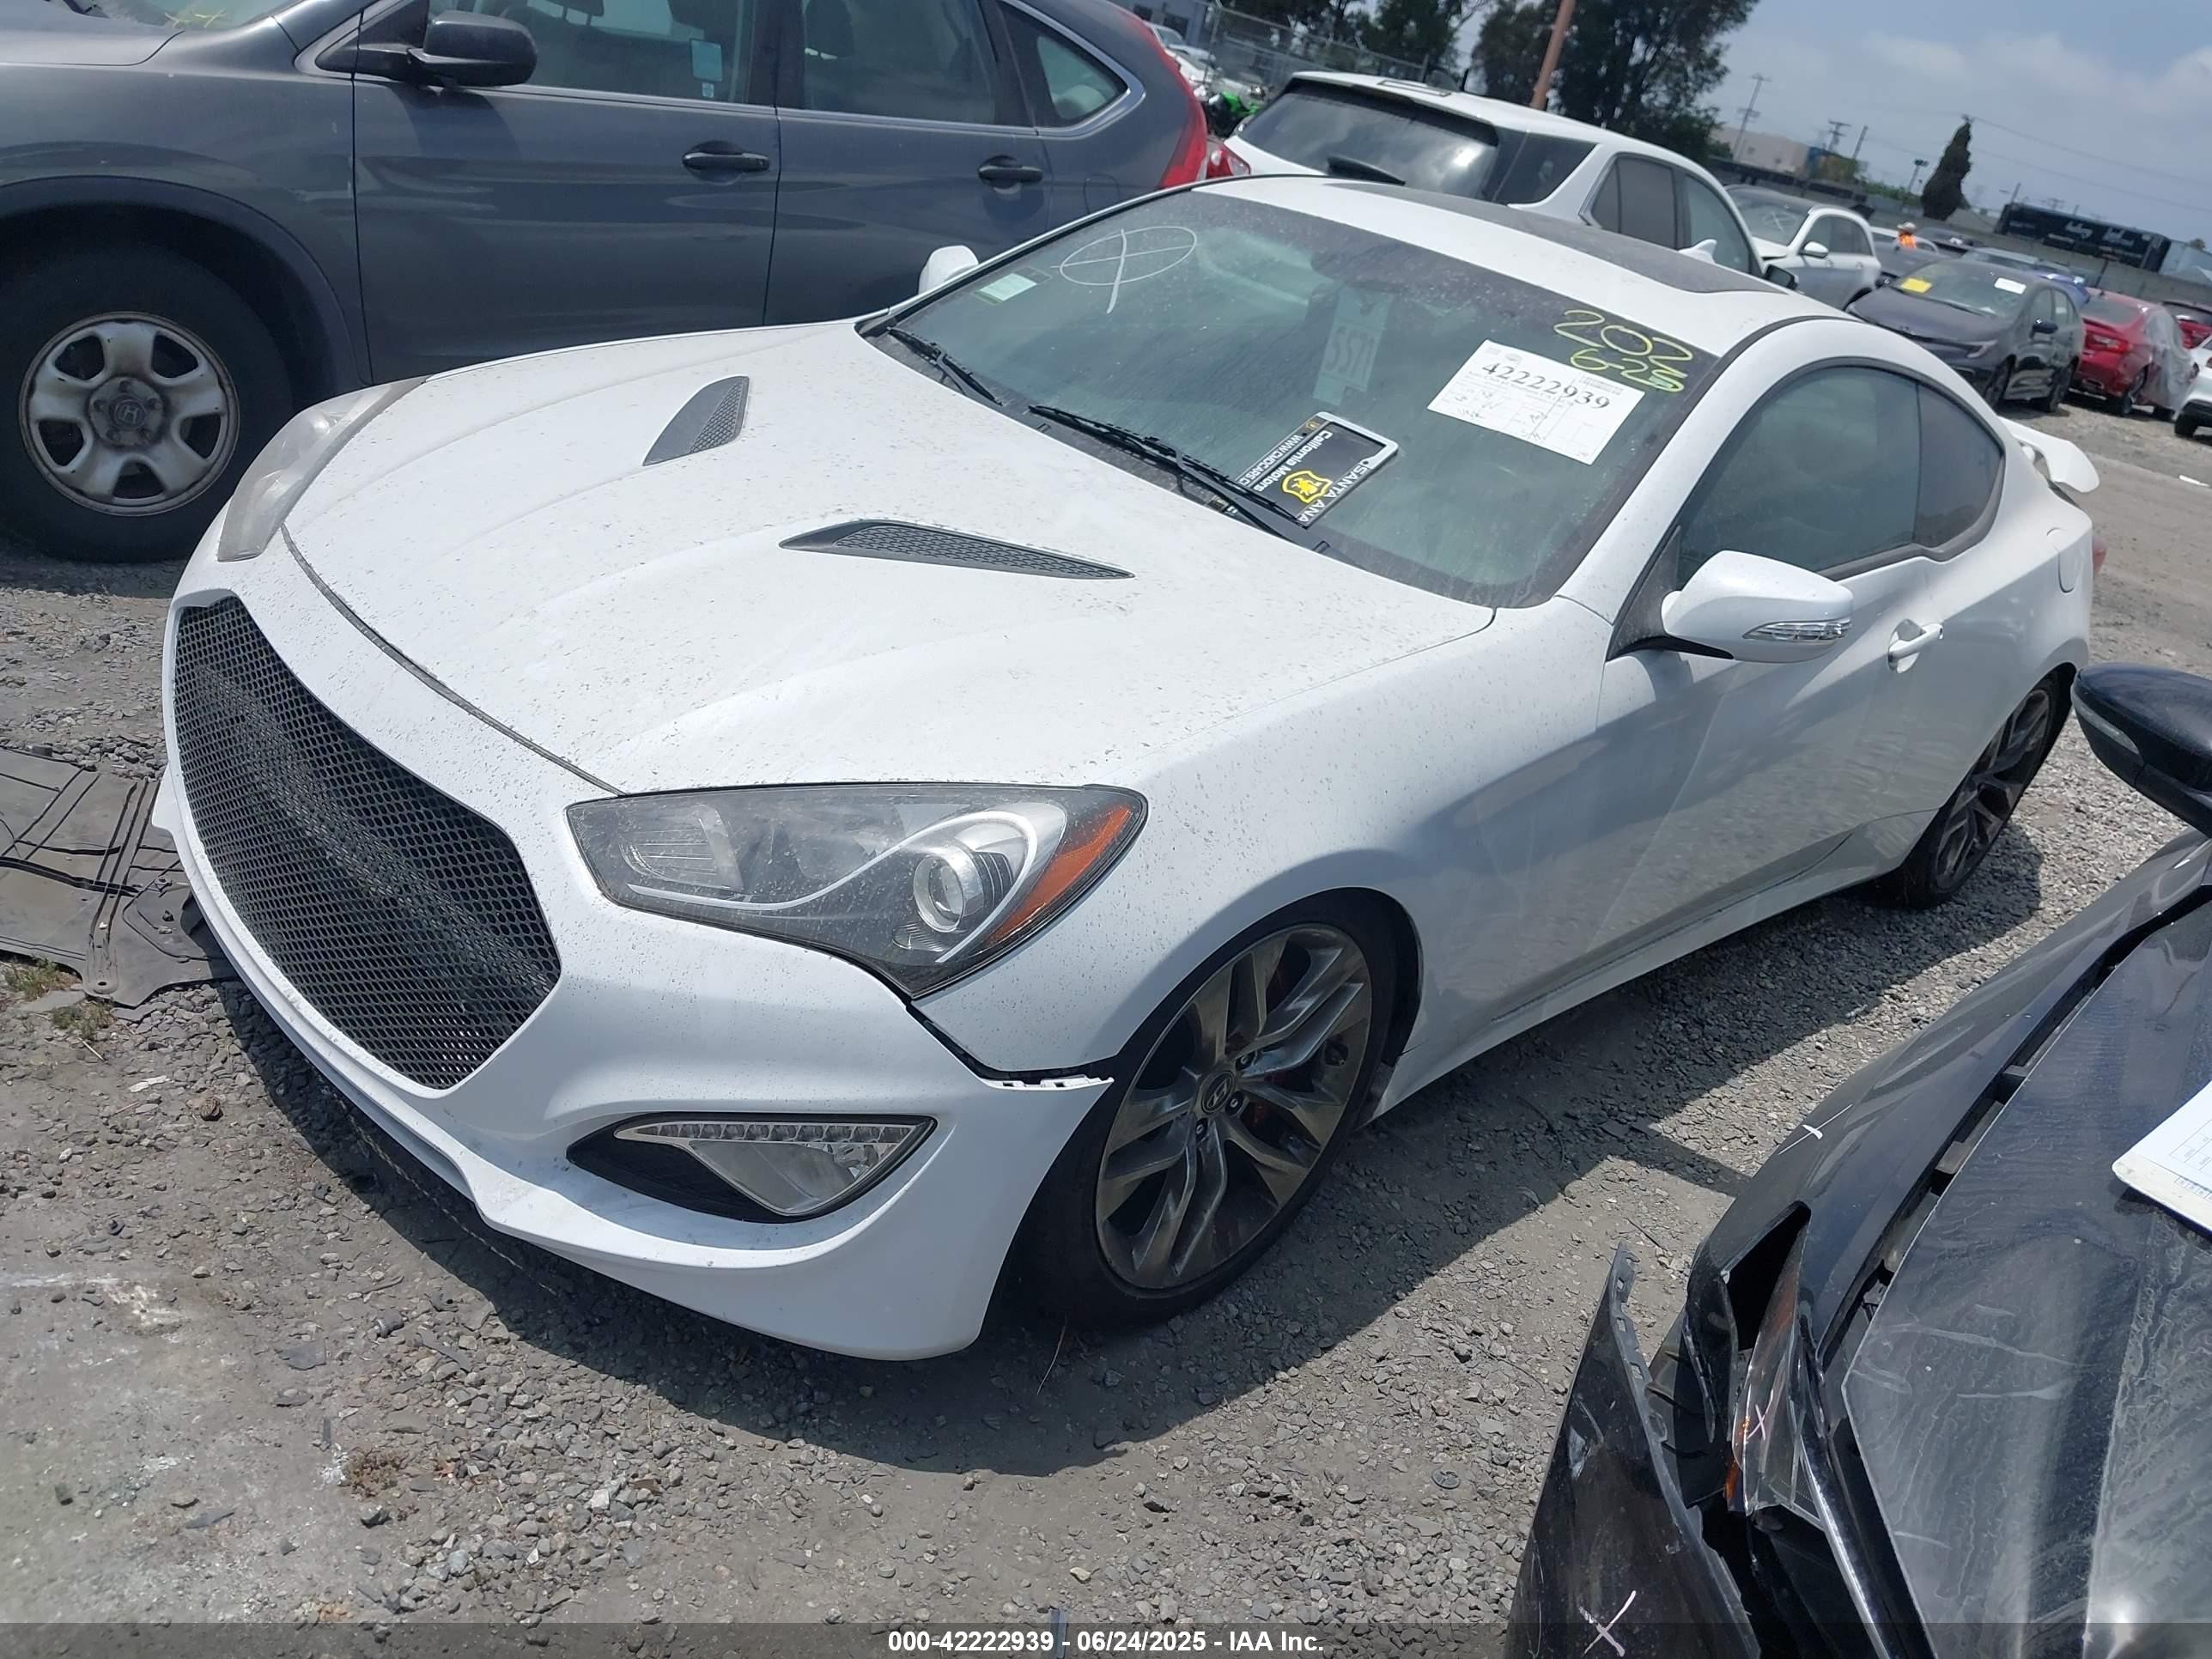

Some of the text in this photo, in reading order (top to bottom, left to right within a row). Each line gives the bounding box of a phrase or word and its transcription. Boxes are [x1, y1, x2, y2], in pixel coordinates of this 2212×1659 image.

[1553, 310, 1693, 379] 202
[1480, 362, 1611, 410] 42222939
[1253, 429, 1334, 492] California Motors
[1297, 464, 1369, 523] SANTA ANA
